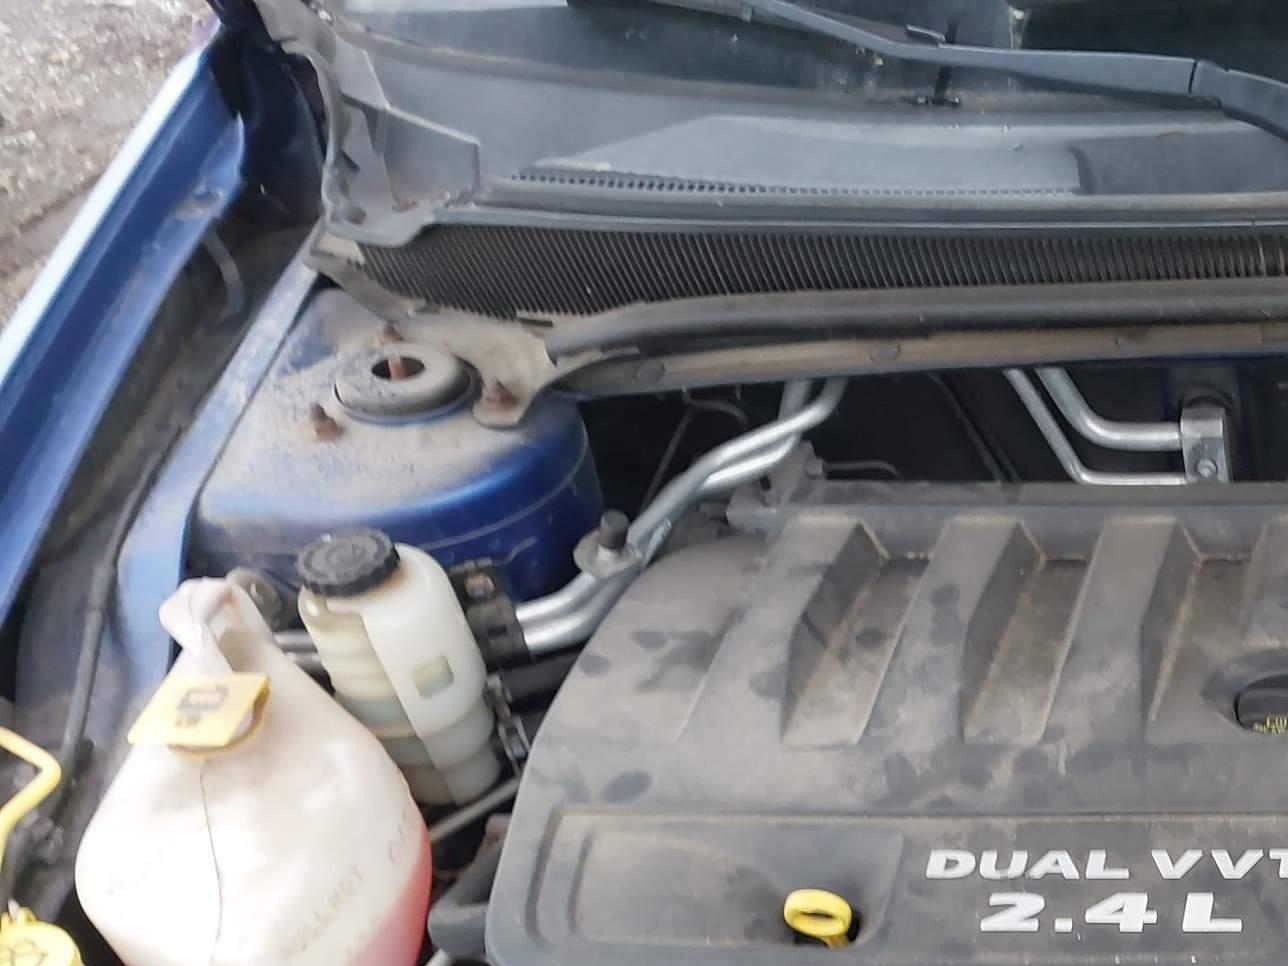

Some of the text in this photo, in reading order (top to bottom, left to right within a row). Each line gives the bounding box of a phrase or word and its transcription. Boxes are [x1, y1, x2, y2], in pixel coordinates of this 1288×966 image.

[925, 848, 1130, 881] DUAL
[979, 890, 1244, 934] 2.4 L
